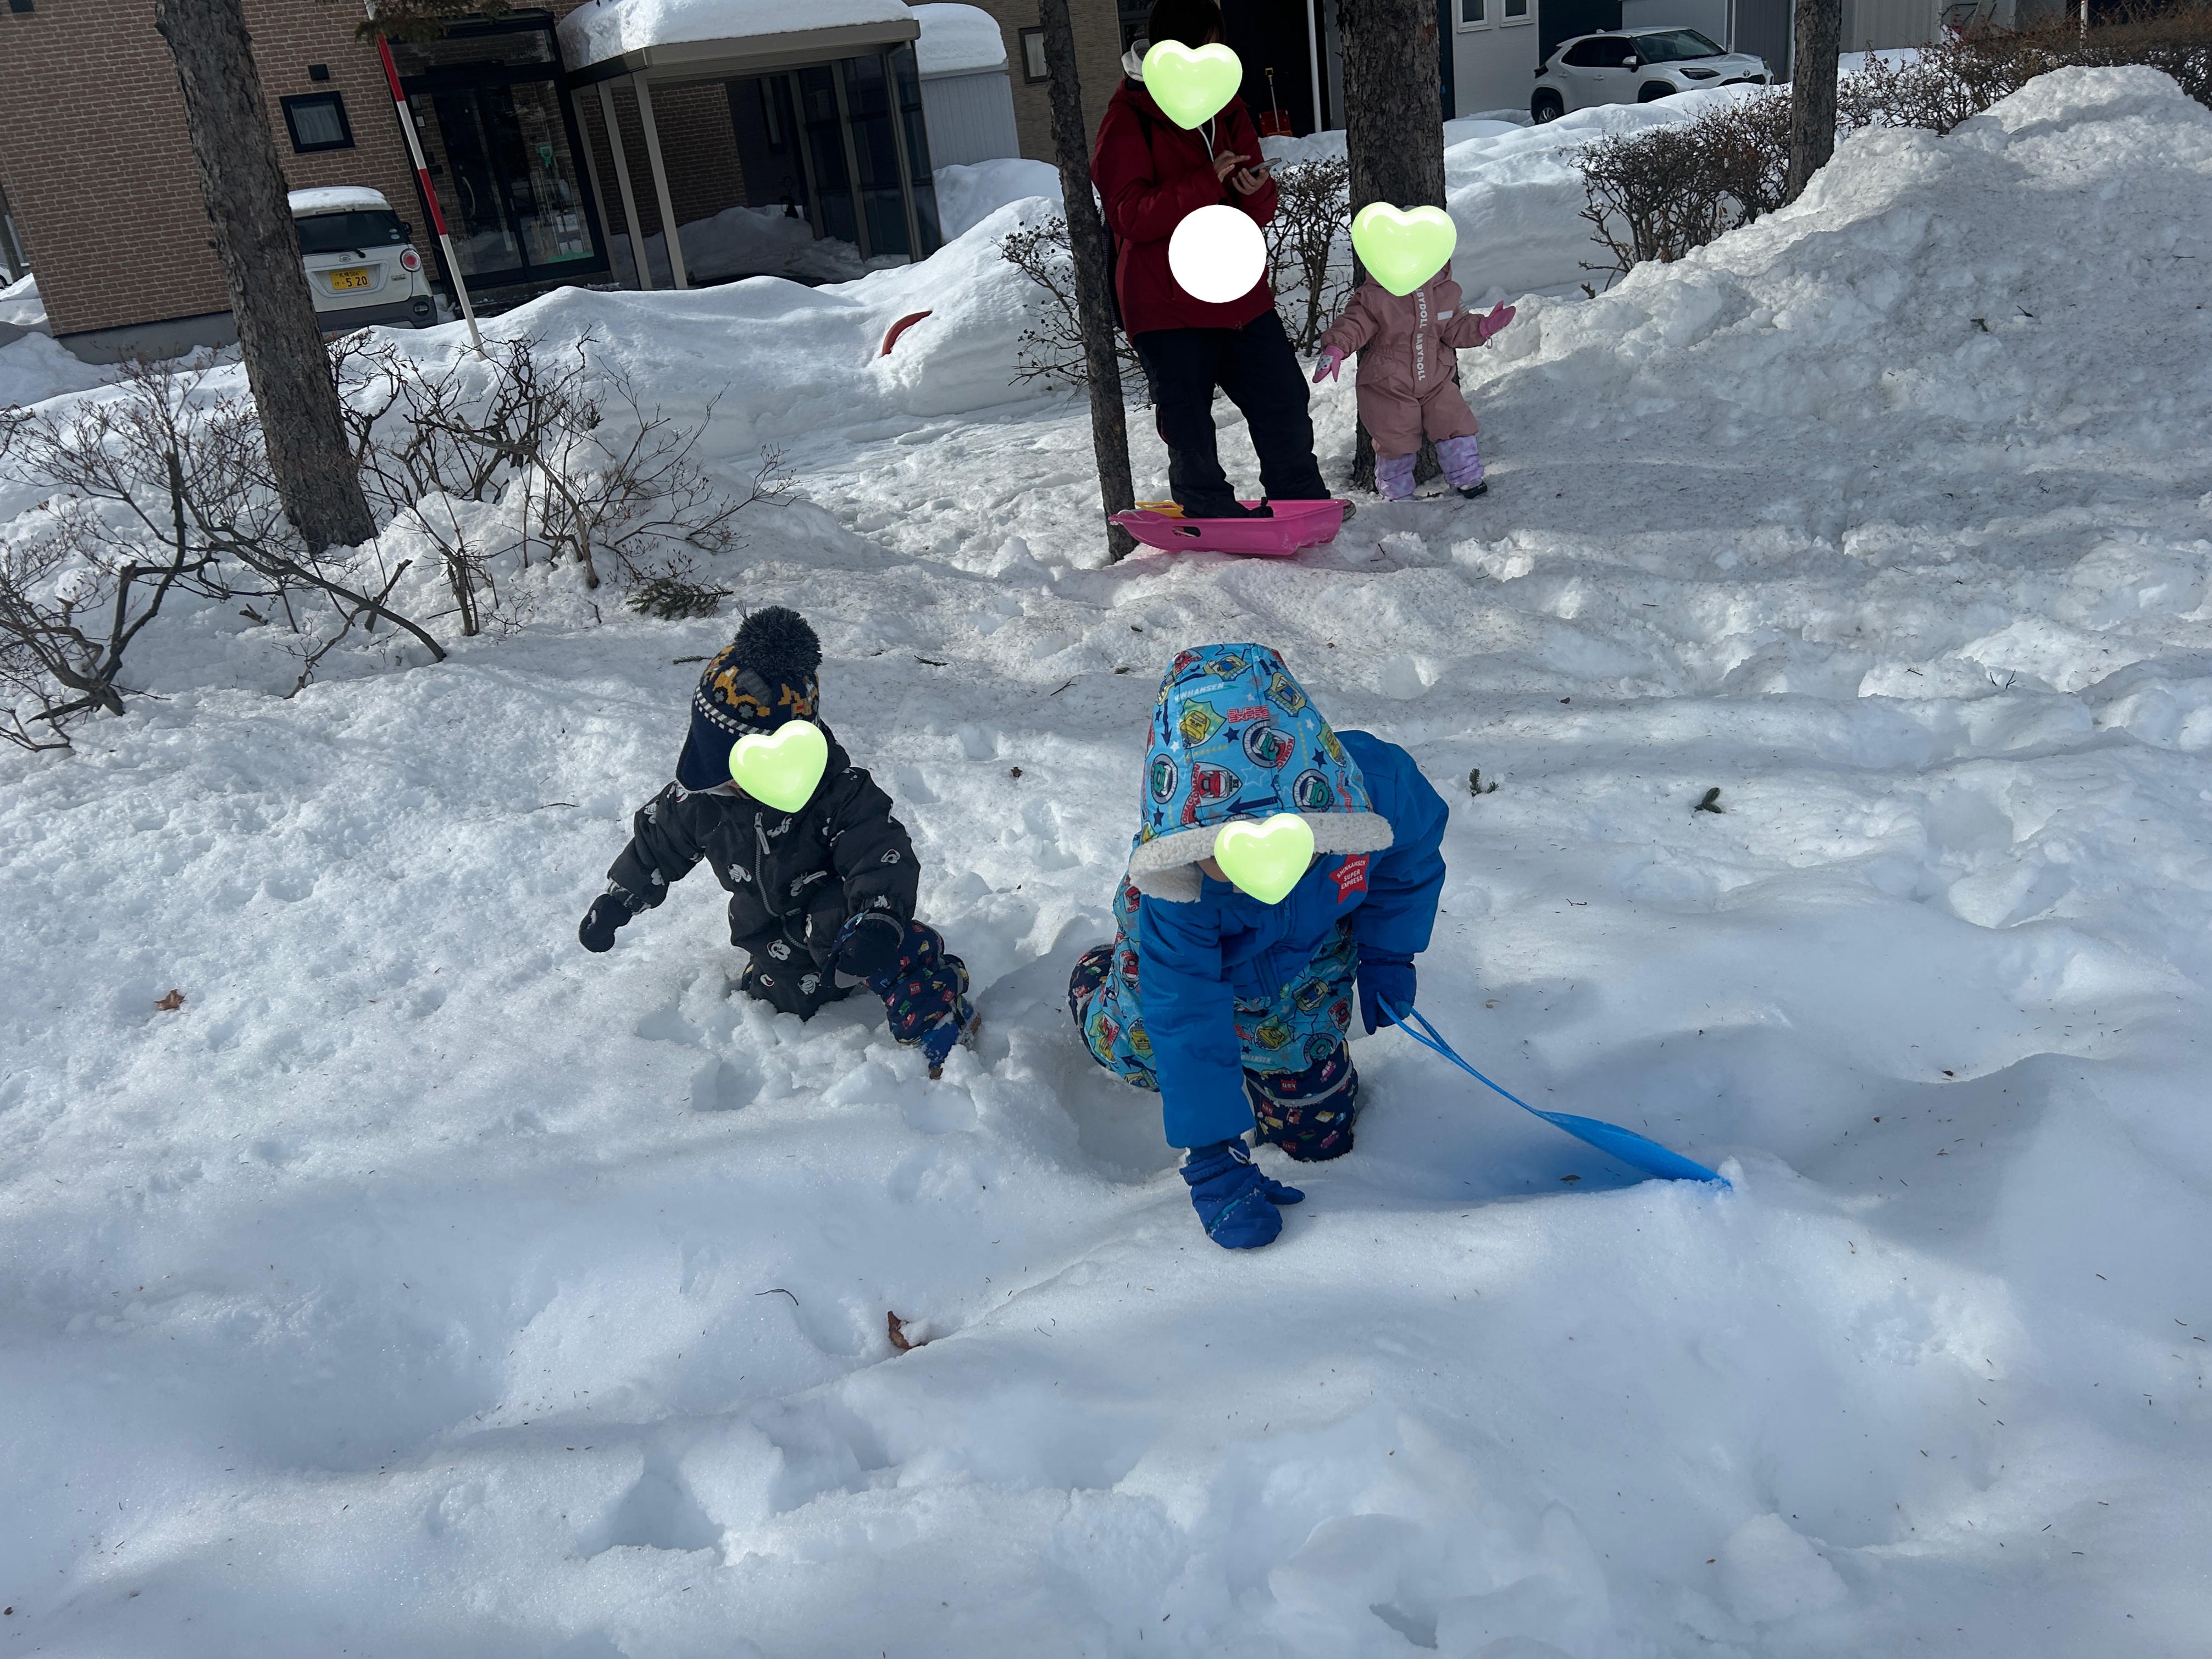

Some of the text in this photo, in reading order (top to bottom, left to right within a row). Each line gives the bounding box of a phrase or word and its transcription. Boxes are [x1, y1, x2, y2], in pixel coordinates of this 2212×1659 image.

[1415, 333, 1426, 381] BABYDOLL
[1336, 860, 1366, 878] SHINKANSEN
[1343, 869, 1361, 881] SUPER
[1341, 874, 1363, 890] EXPRESS
